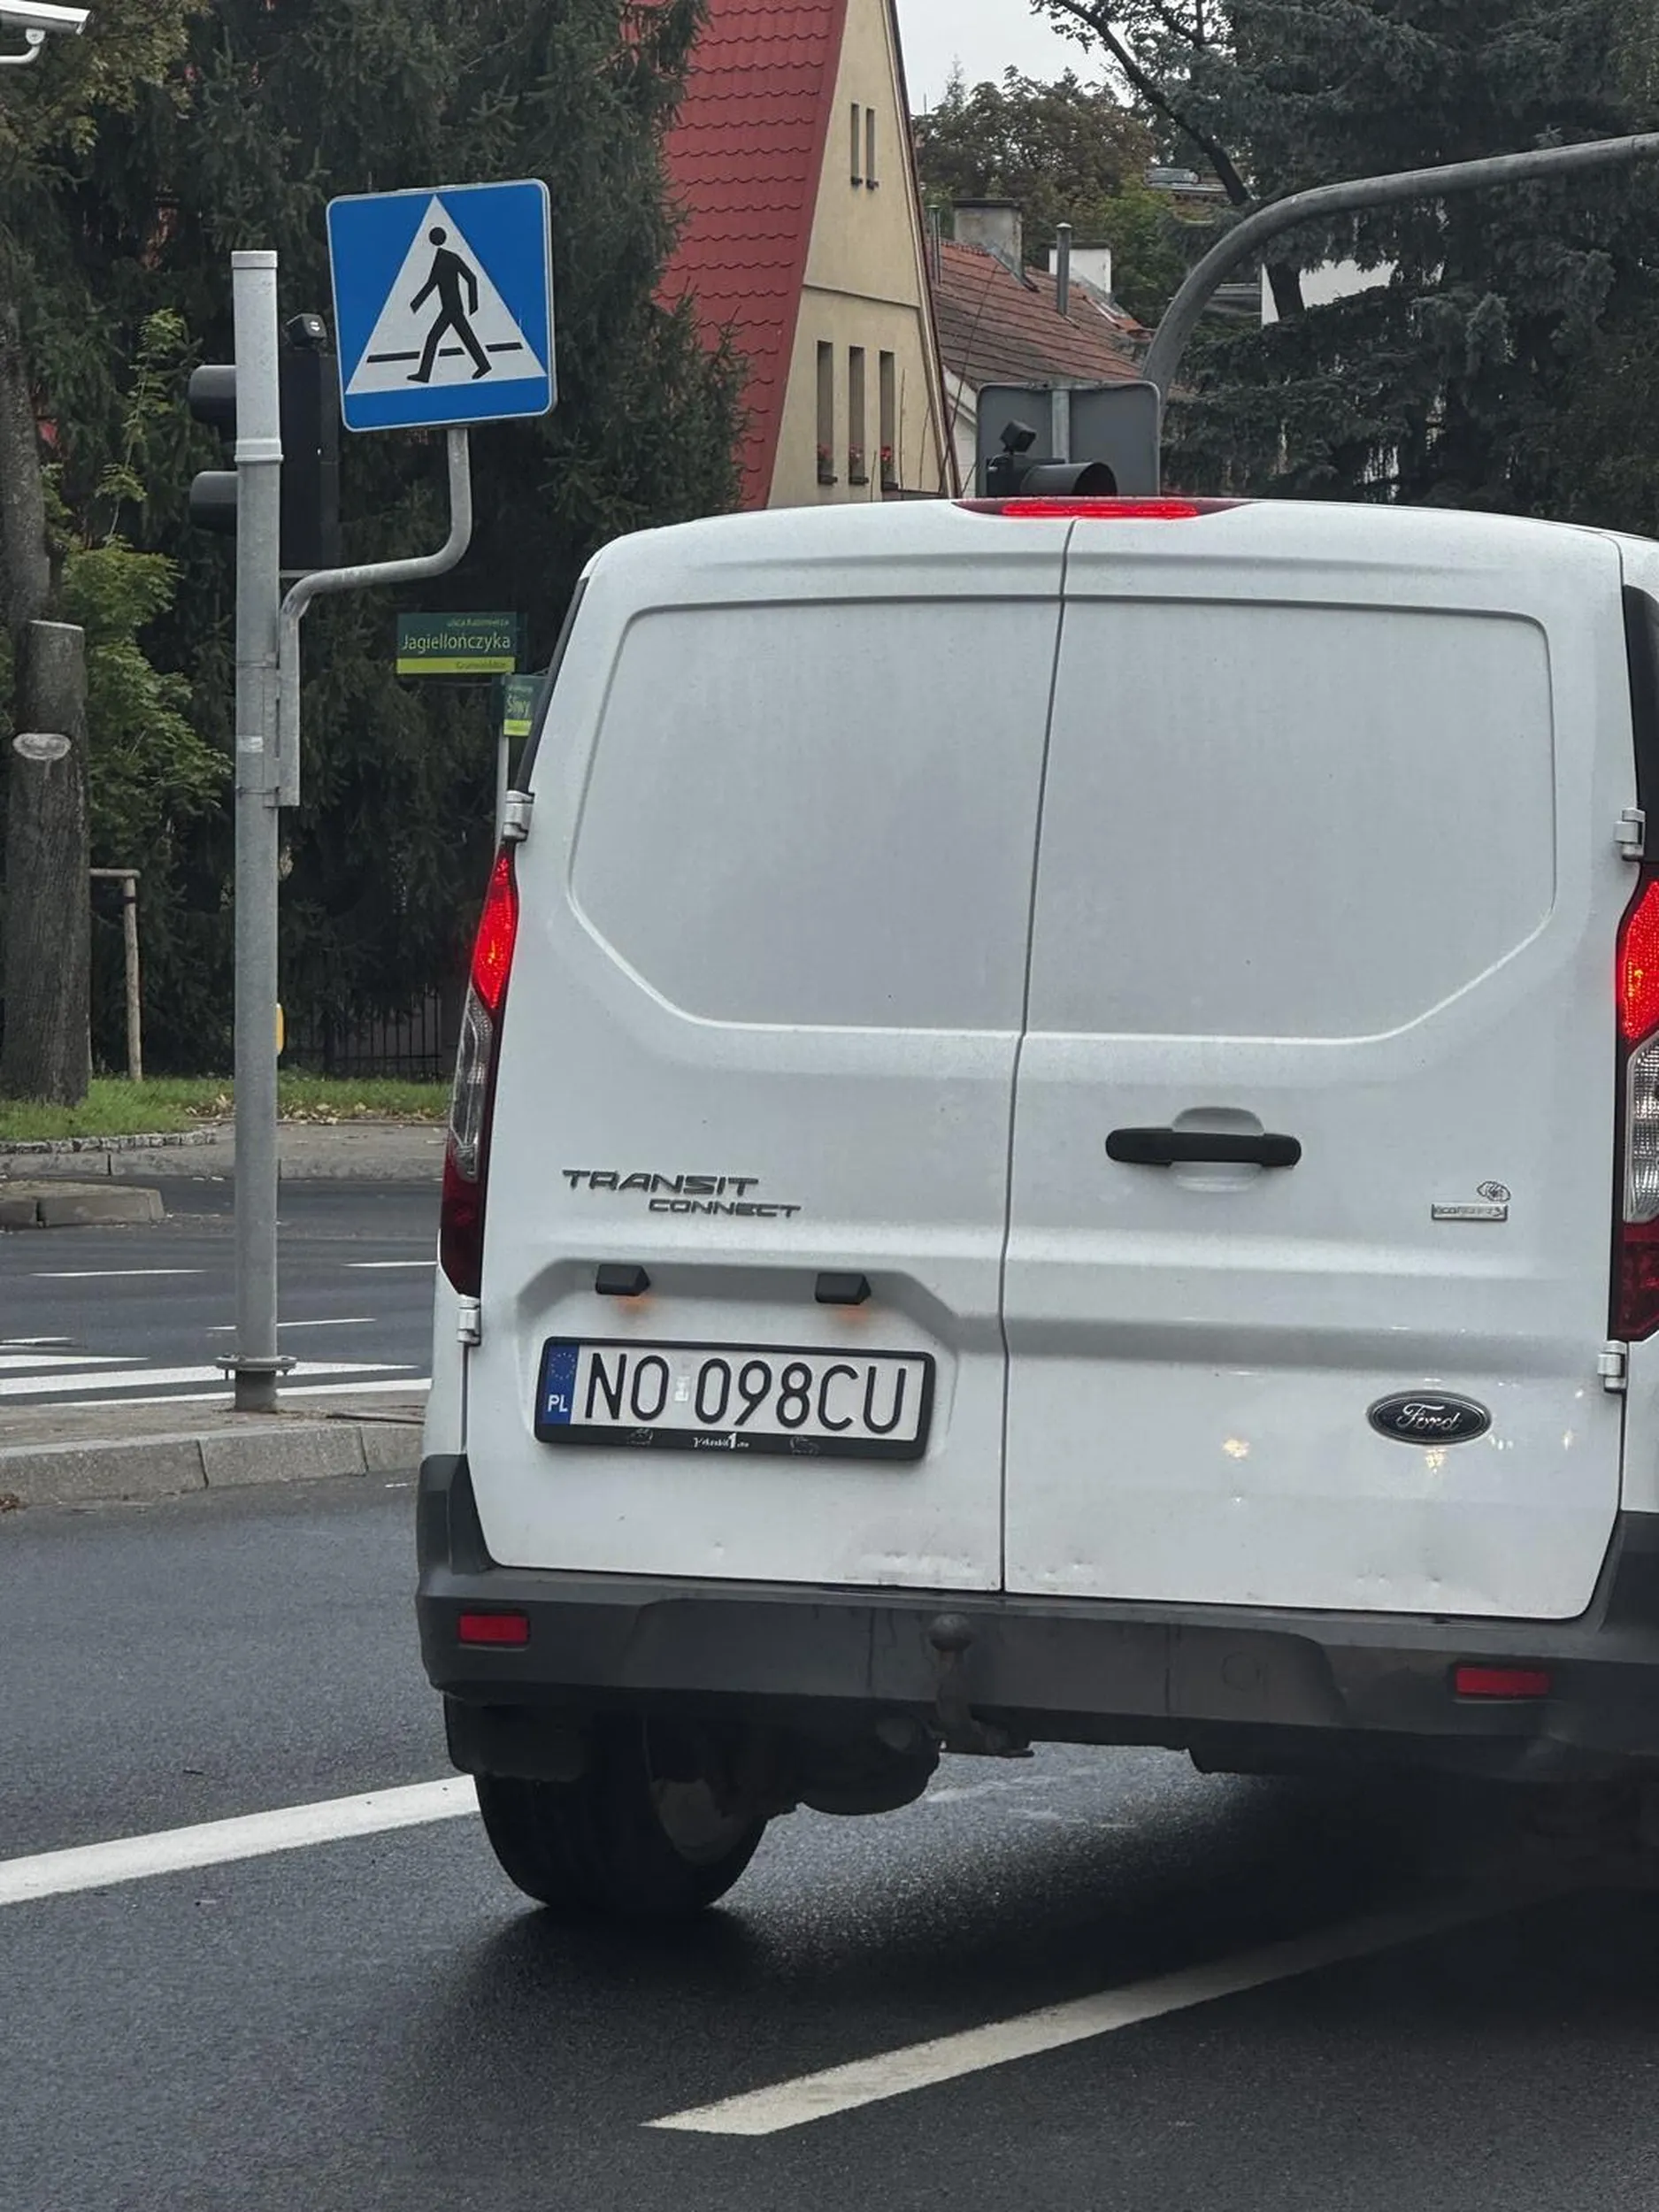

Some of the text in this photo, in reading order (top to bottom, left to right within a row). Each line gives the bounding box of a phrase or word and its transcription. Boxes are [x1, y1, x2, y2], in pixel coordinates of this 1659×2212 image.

[403, 632, 511, 655] Jagiellończyka
[562, 1169, 759, 1197] TRANSIT
[649, 1197, 802, 1218] CONNECT
[547, 1394, 568, 1413] PL
[585, 1352, 907, 1434] NO 098CU
[1396, 1402, 1462, 1431] Ford
